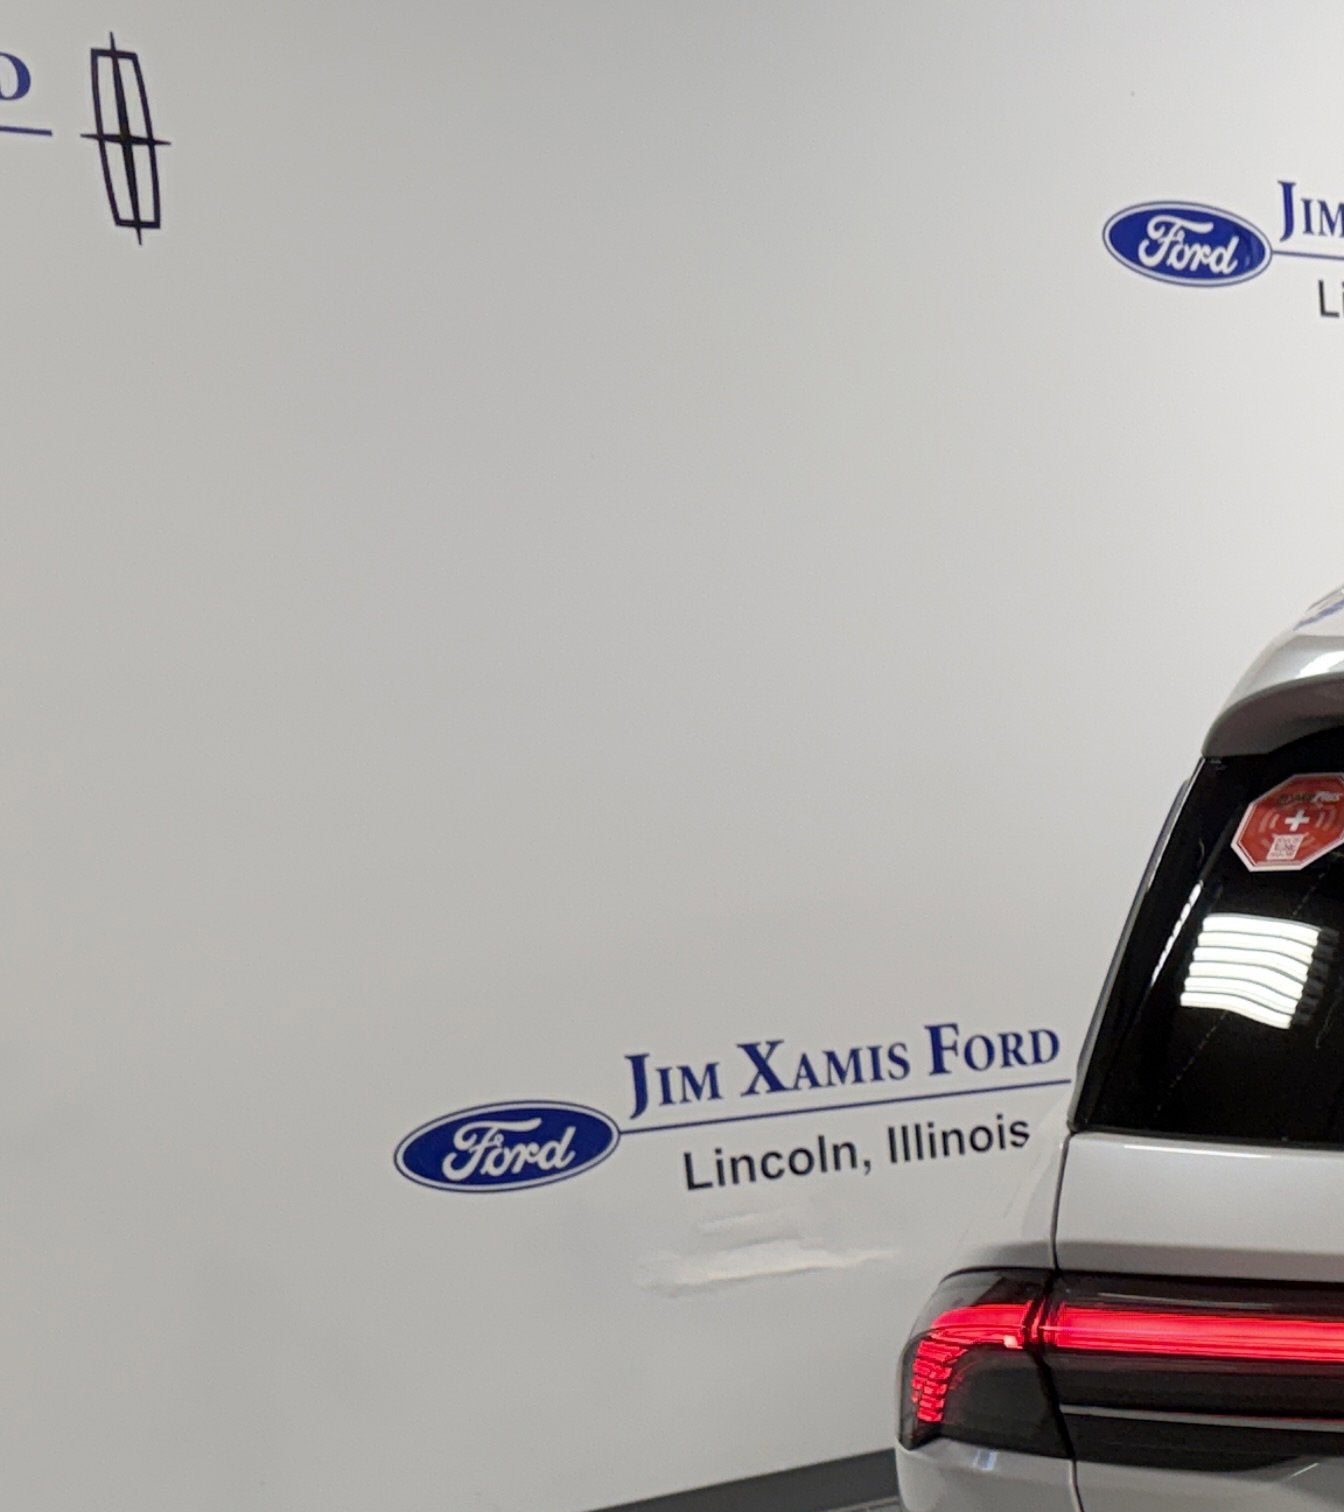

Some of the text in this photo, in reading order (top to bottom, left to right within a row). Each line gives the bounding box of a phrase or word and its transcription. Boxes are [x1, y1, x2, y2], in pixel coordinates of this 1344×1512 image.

[1138, 215, 1239, 275] Ford
[624, 1023, 1060, 1120] JIM XAMIS FORD
[442, 1118, 577, 1180] Ford
[683, 1114, 1031, 1191] Lincoln, Illinois
